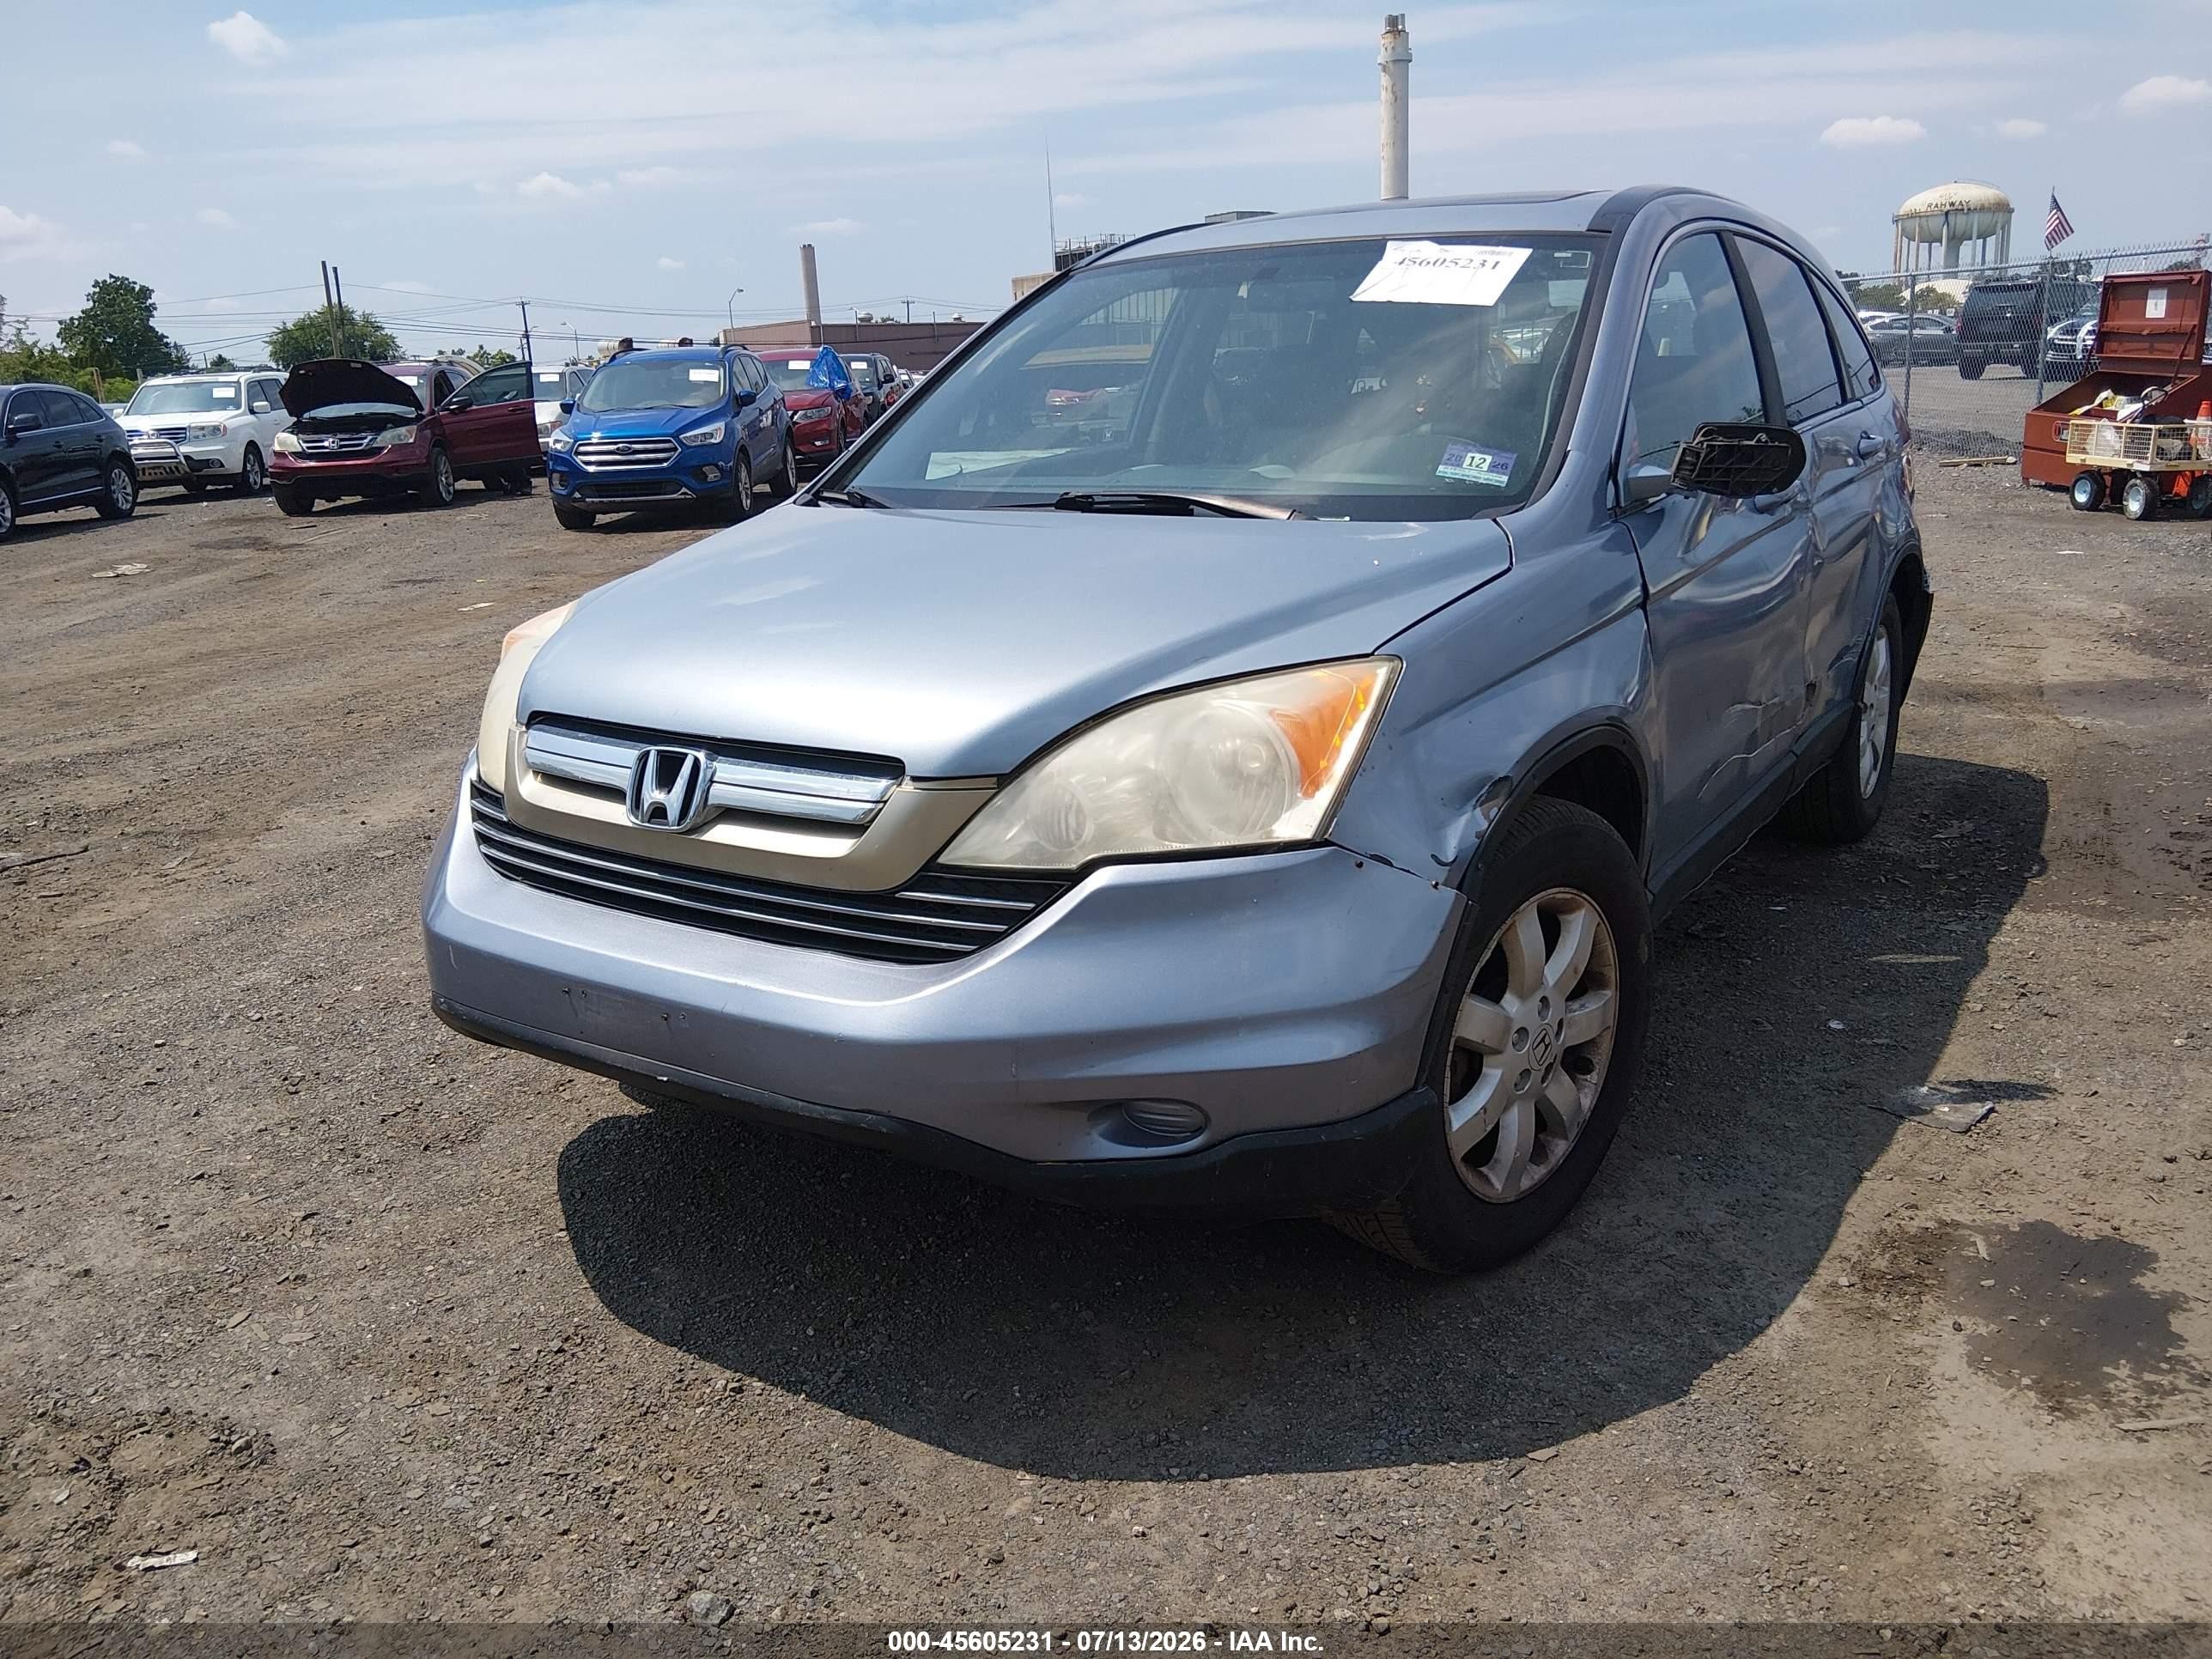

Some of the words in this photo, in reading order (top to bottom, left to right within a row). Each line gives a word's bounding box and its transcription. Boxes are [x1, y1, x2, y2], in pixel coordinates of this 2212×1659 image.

[1927, 200, 1971, 210] RAHWAY
[1395, 257, 1501, 270] 45605231
[1446, 453, 1462, 463] 20
[1467, 456, 1486, 469] 12
[1492, 461, 1509, 471] 26
